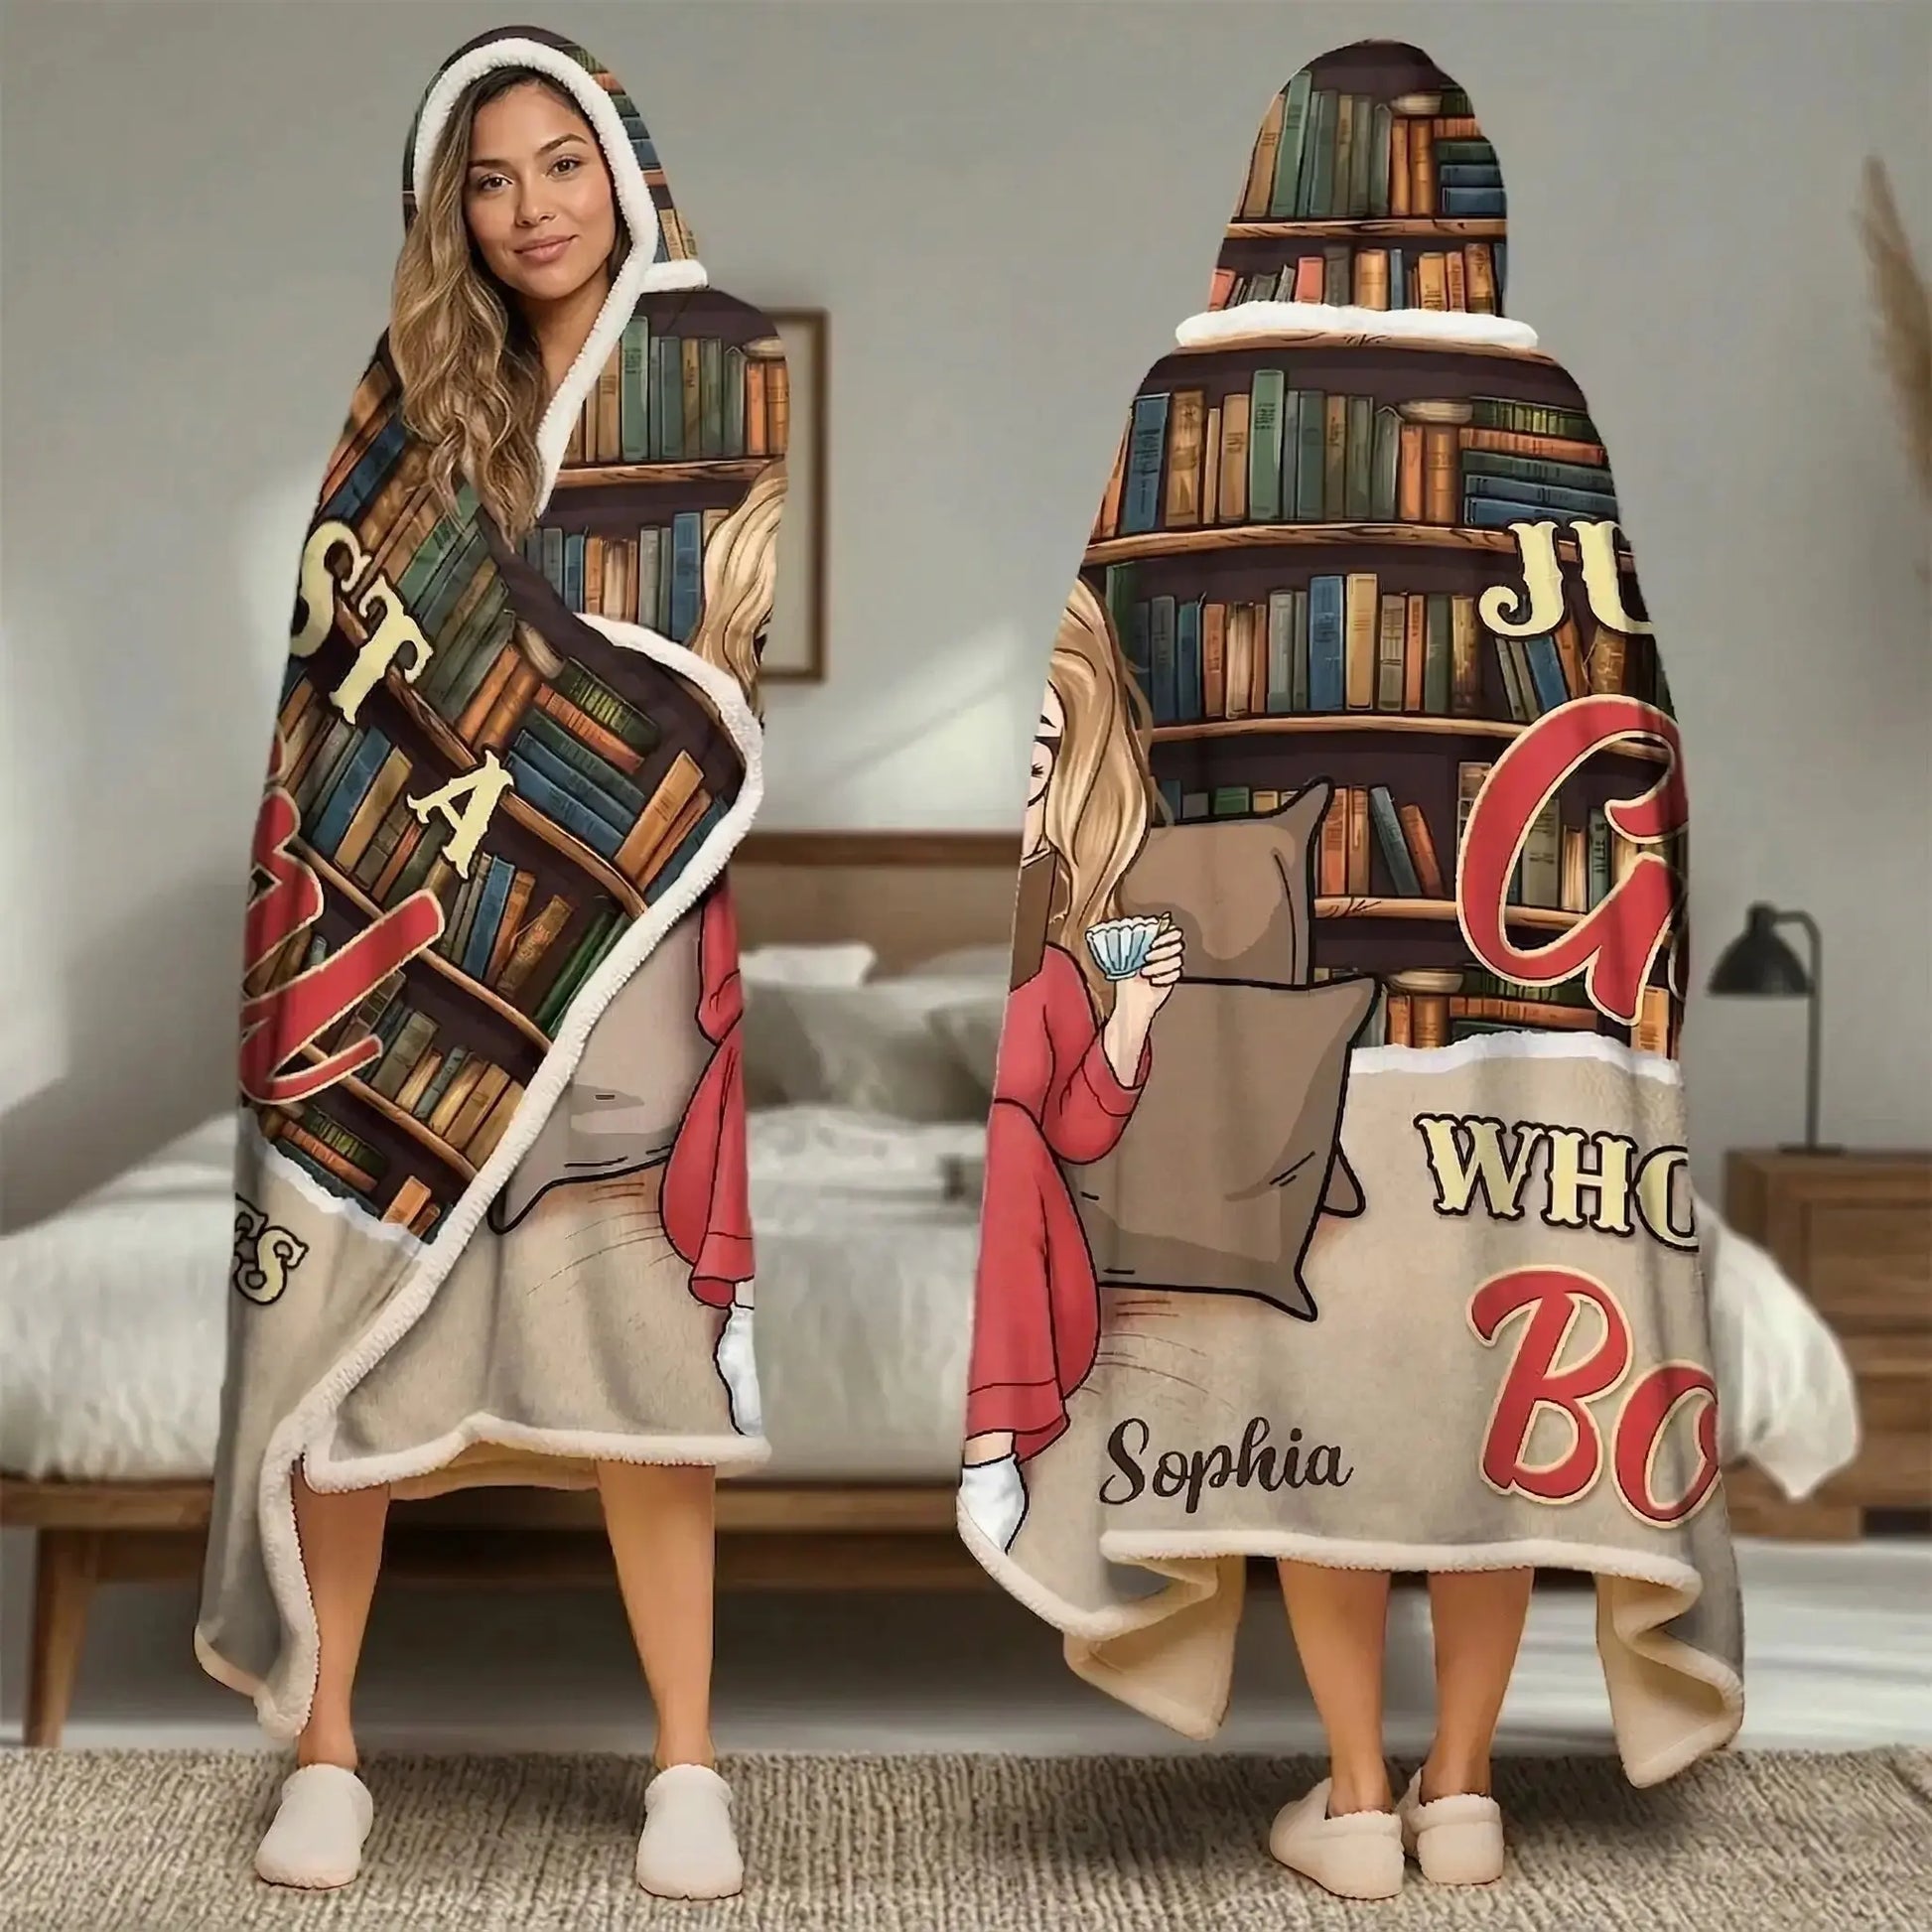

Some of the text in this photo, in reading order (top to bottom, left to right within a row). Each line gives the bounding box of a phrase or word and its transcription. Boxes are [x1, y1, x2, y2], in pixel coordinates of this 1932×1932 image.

[406, 749, 515, 881] A
[1455, 694, 1690, 1027] G
[1414, 1112, 1700, 1253] WHO
[1099, 1416, 1354, 1514] Sophia
